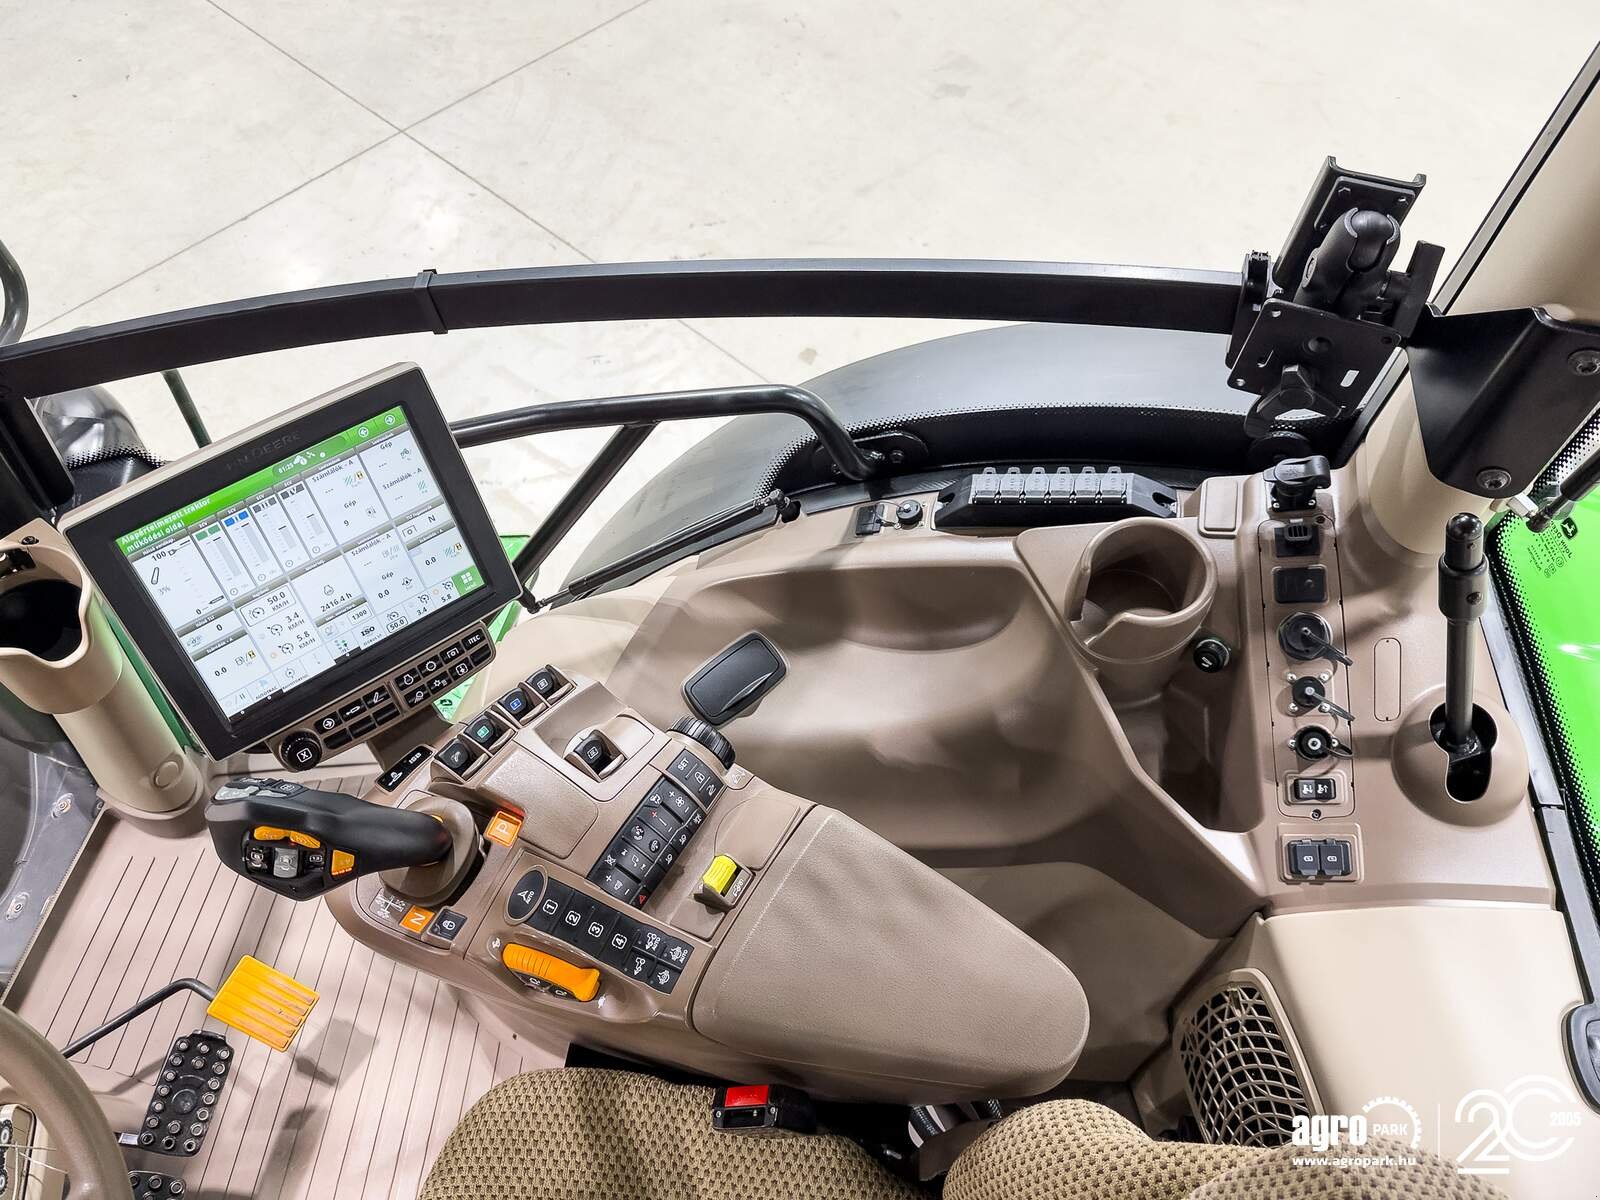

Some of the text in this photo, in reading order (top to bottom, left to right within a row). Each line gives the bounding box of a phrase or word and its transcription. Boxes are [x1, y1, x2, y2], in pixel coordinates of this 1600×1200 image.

[379, 440, 393, 451] Gép
[343, 498, 357, 509] Gép
[122, 499, 211, 544] Alapértelmezett traktor
[427, 514, 436, 523] N
[126, 531, 164, 552] működési
[166, 520, 184, 534] oldal
[151, 550, 167, 562] 100
[424, 555, 437, 566] 0.0
[380, 570, 394, 581] Gép
[266, 590, 286, 605] 50.0
[377, 588, 390, 599] 0.0
[440, 593, 451, 602] 5.8
[270, 598, 290, 612] KM/H
[319, 591, 352, 612] 2416.4 h
[351, 609, 367, 620] 1300
[415, 606, 427, 615] 3.4
[284, 611, 300, 623] 3.4
[215, 623, 224, 632] 0
[287, 618, 305, 631] KM/H
[360, 624, 375, 636] ISO
[389, 618, 405, 630] 50.0
[295, 630, 310, 642] 5.8
[467, 634, 481, 645] ITEC
[298, 637, 316, 649] KM/H
[213, 665, 228, 677] 0.0
[677, 757, 689, 771] SET
[525, 890, 535, 905] AUTO
[651, 935, 661, 952] AUTO
[679, 949, 688, 963] AUTO
